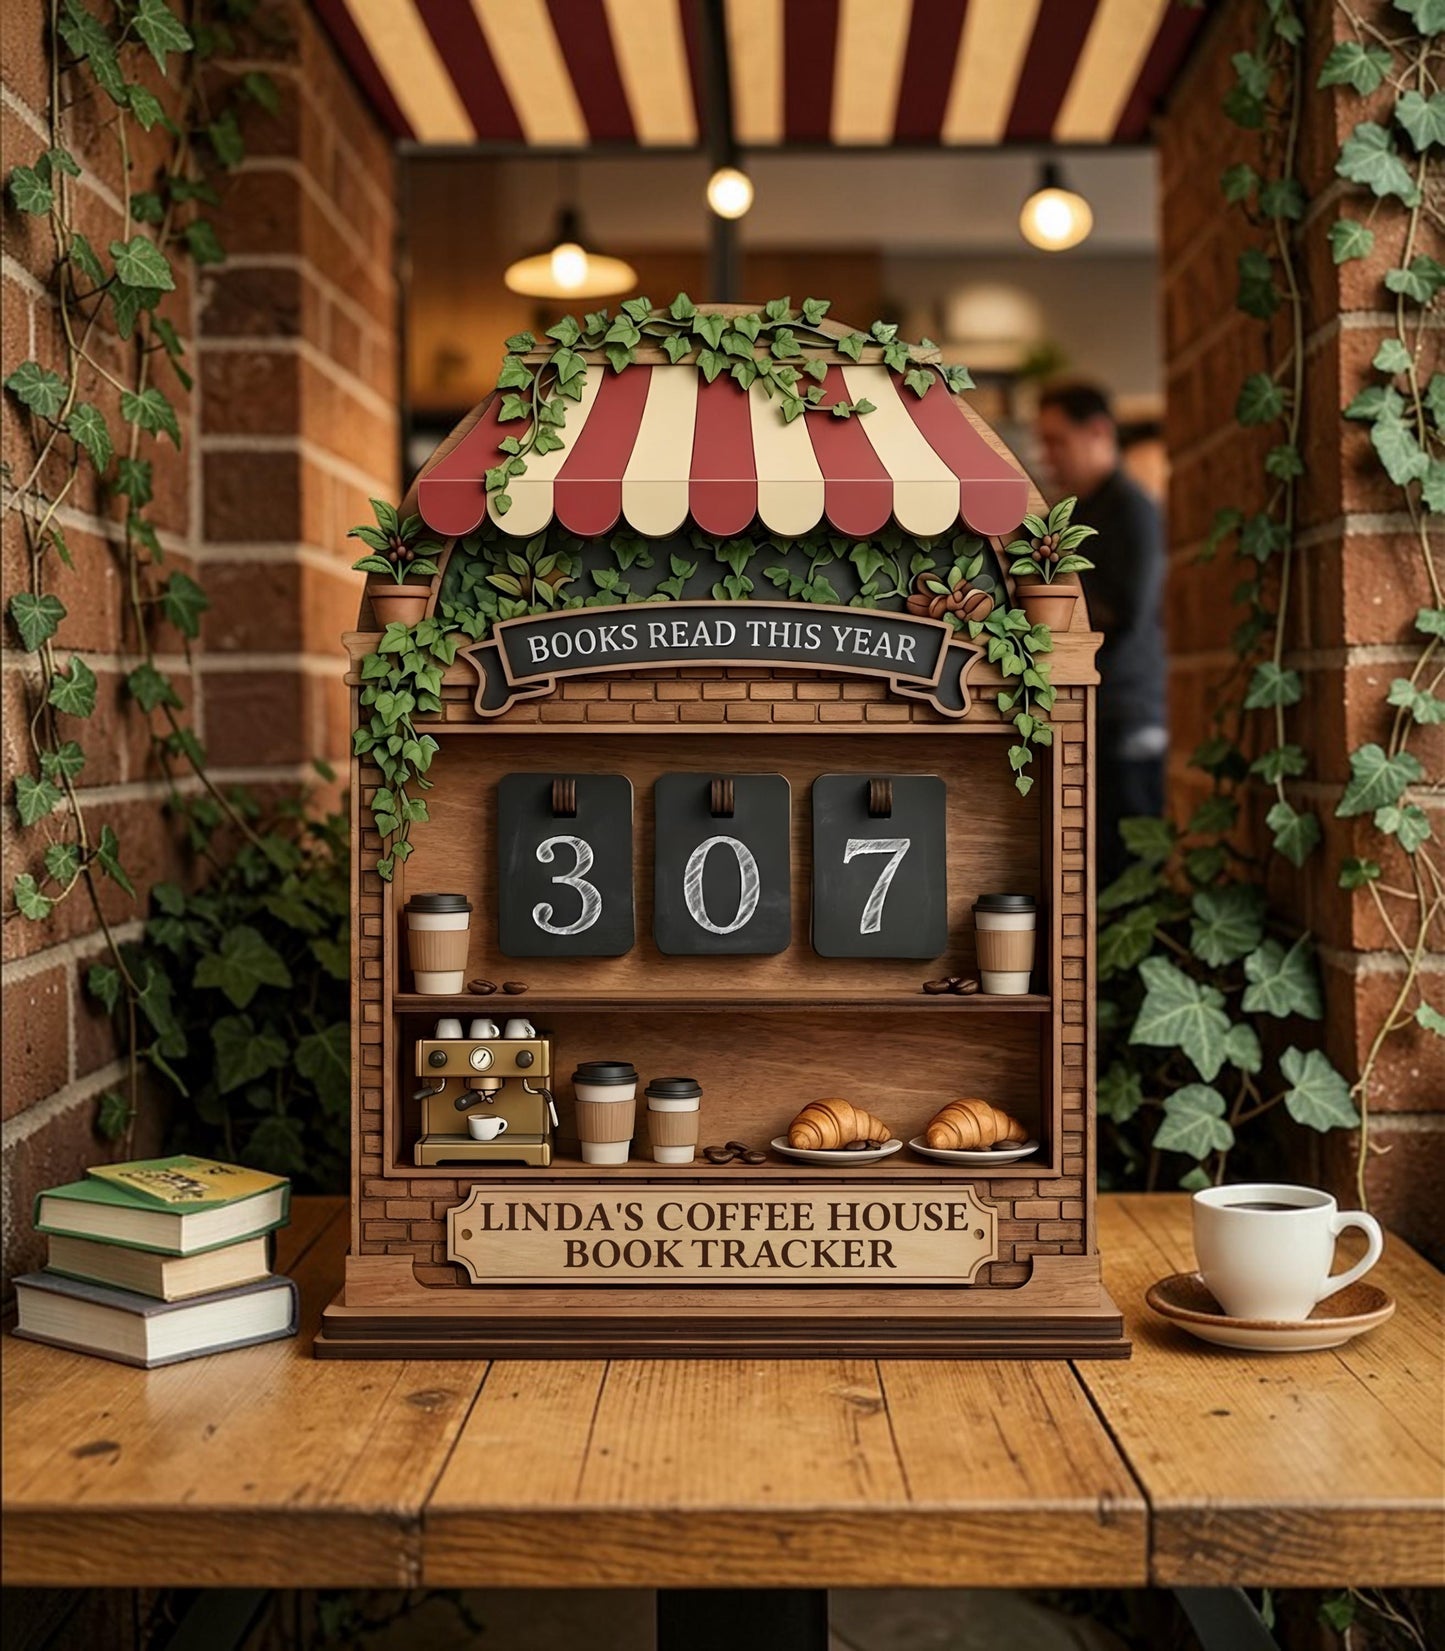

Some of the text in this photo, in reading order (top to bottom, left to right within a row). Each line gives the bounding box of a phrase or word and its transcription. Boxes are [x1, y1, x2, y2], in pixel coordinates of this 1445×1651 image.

[527, 620, 917, 663] BOOKS READ THIS YEAR
[532, 835, 602, 936] 3
[842, 838, 911, 935] 7
[479, 1202, 969, 1232] LINDA'S COFFEE HOUSE
[563, 1239, 898, 1269] BOOK TRACKER
